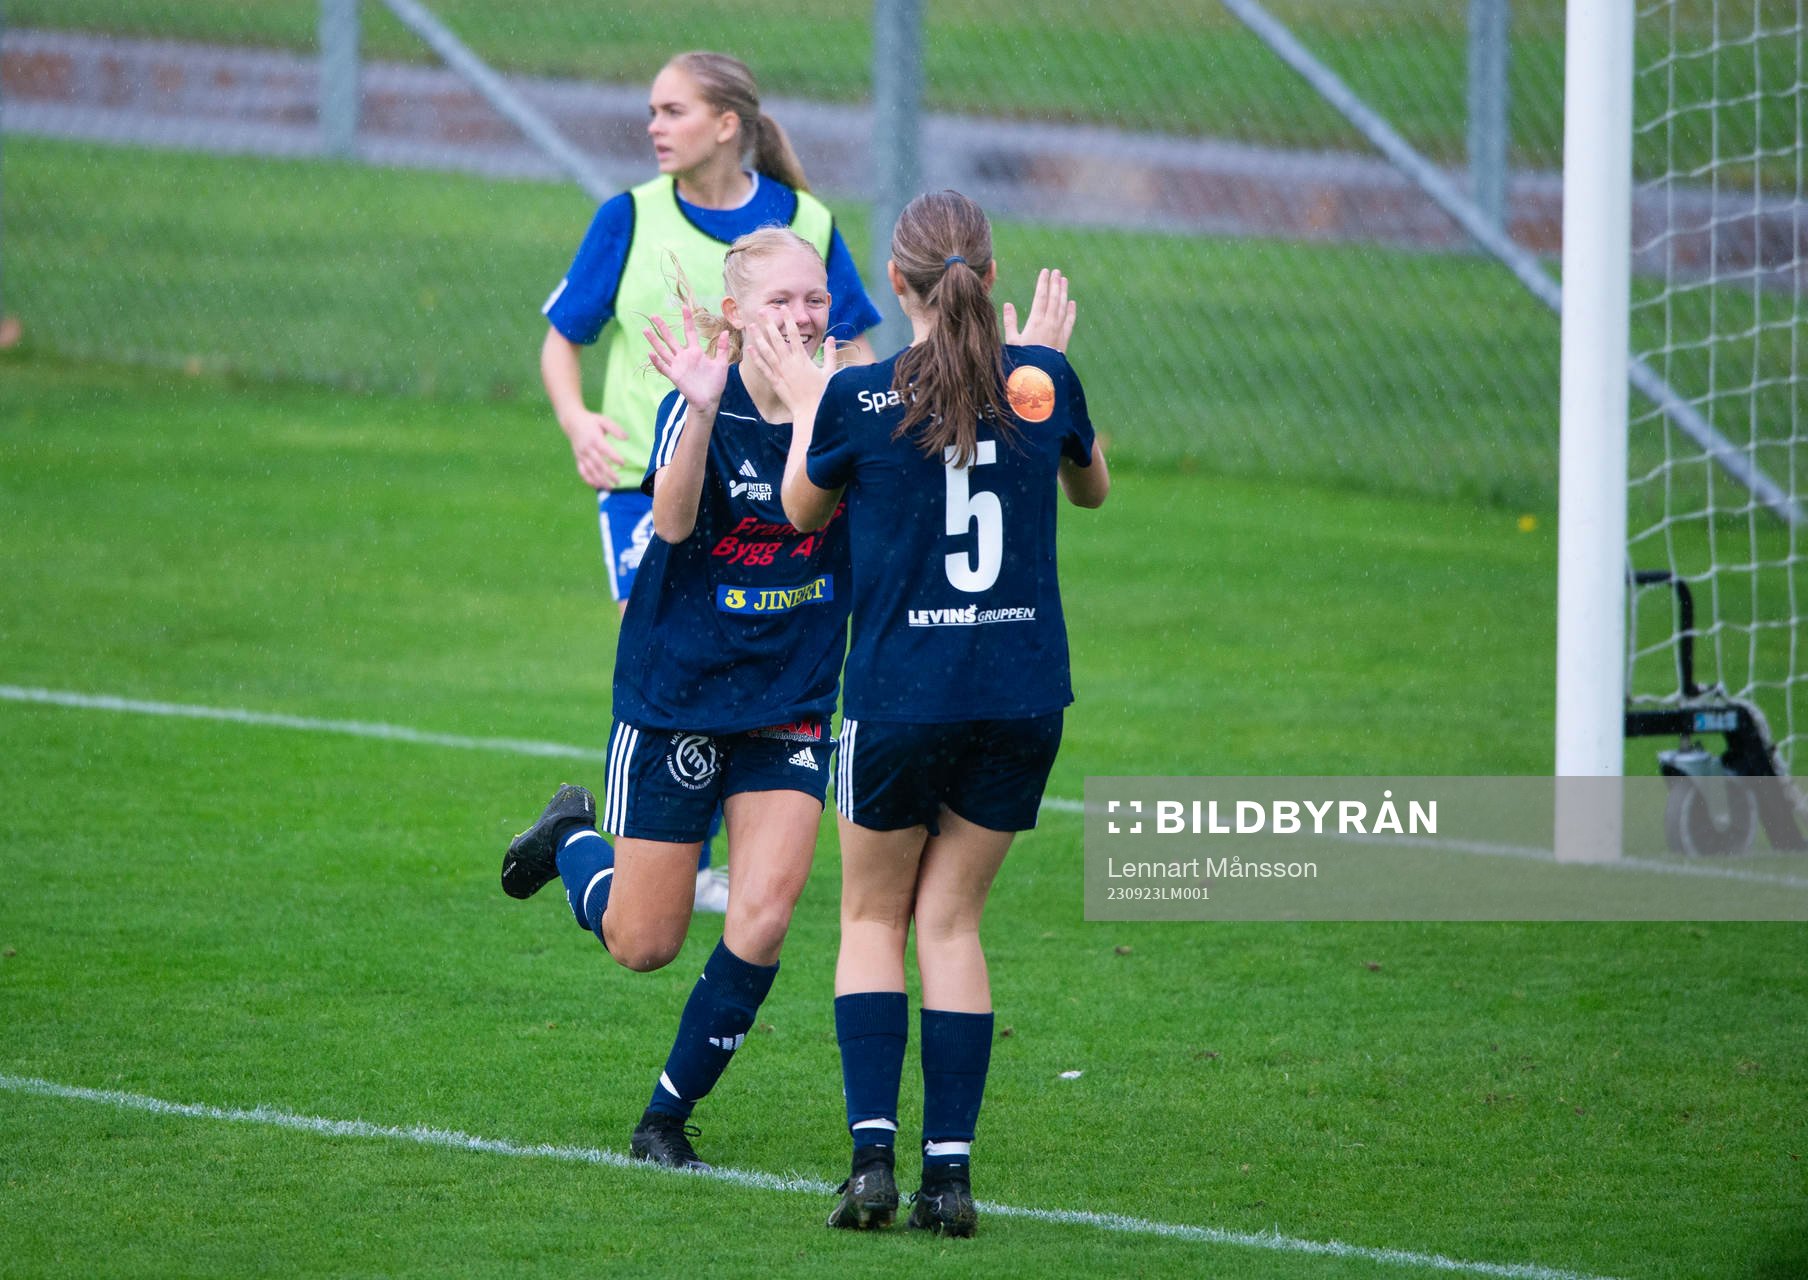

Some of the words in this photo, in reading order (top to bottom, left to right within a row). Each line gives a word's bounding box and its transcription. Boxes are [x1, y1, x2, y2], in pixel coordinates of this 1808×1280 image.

[748, 482, 772, 492] INTER
[746, 491, 773, 501] SPORT
[945, 440, 1003, 593] 5
[711, 536, 783, 566] Bygg
[790, 532, 826, 558] A
[908, 606, 977, 625] LEVINS
[977, 606, 1036, 622] GRUPPEN
[788, 757, 819, 772] adidas
